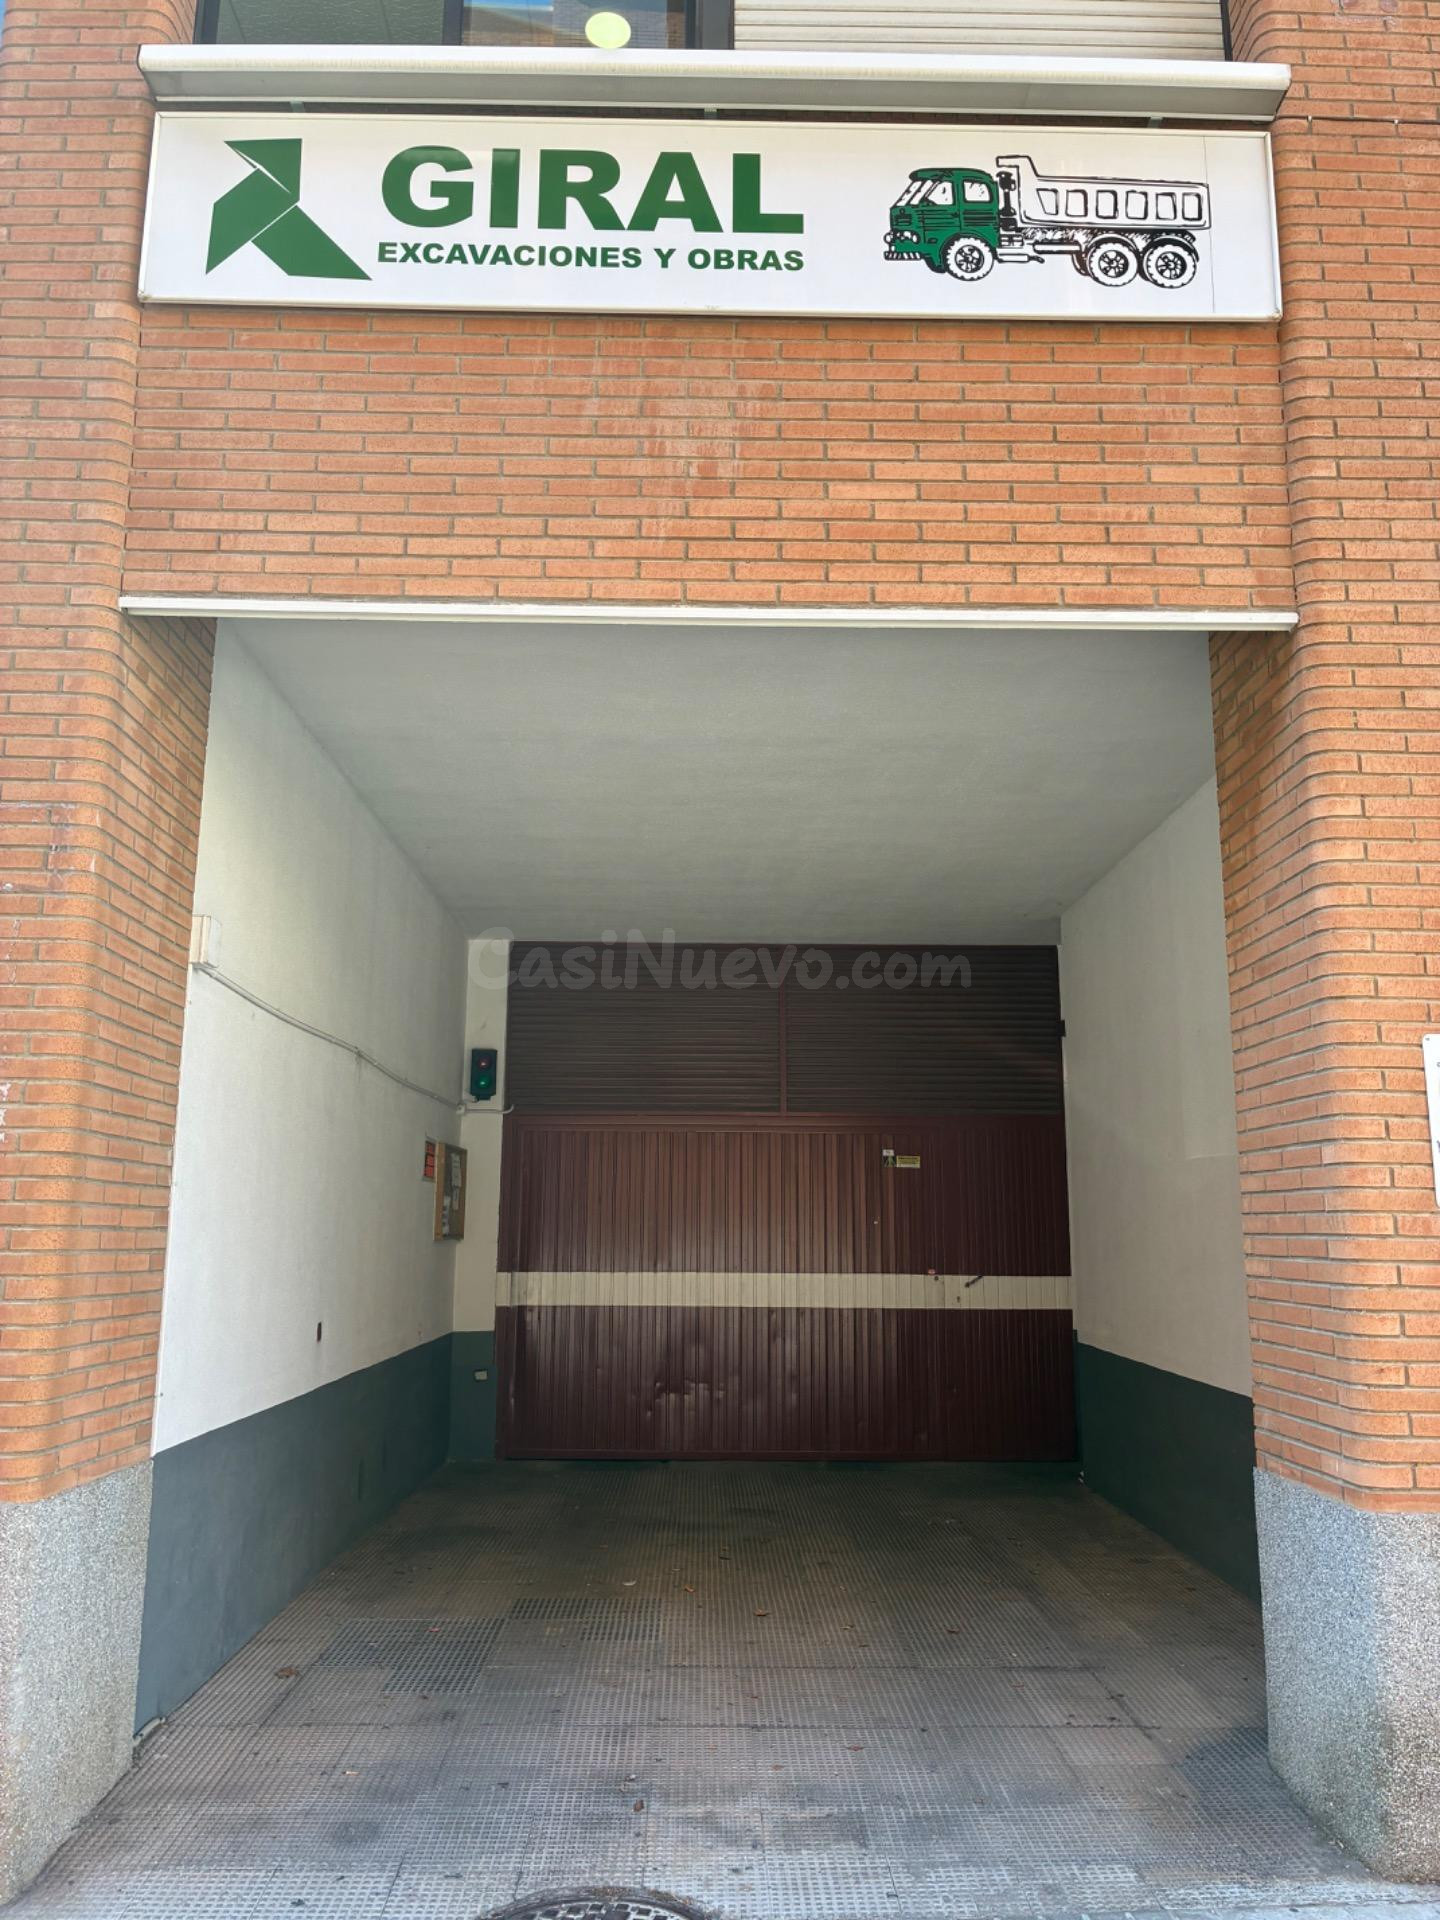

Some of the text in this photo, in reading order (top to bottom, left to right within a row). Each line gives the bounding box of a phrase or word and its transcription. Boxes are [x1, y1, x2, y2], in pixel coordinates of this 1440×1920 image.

[382, 146, 804, 234] GIRAL
[377, 242, 804, 271] EXCAVACIONES Y OBRAS
